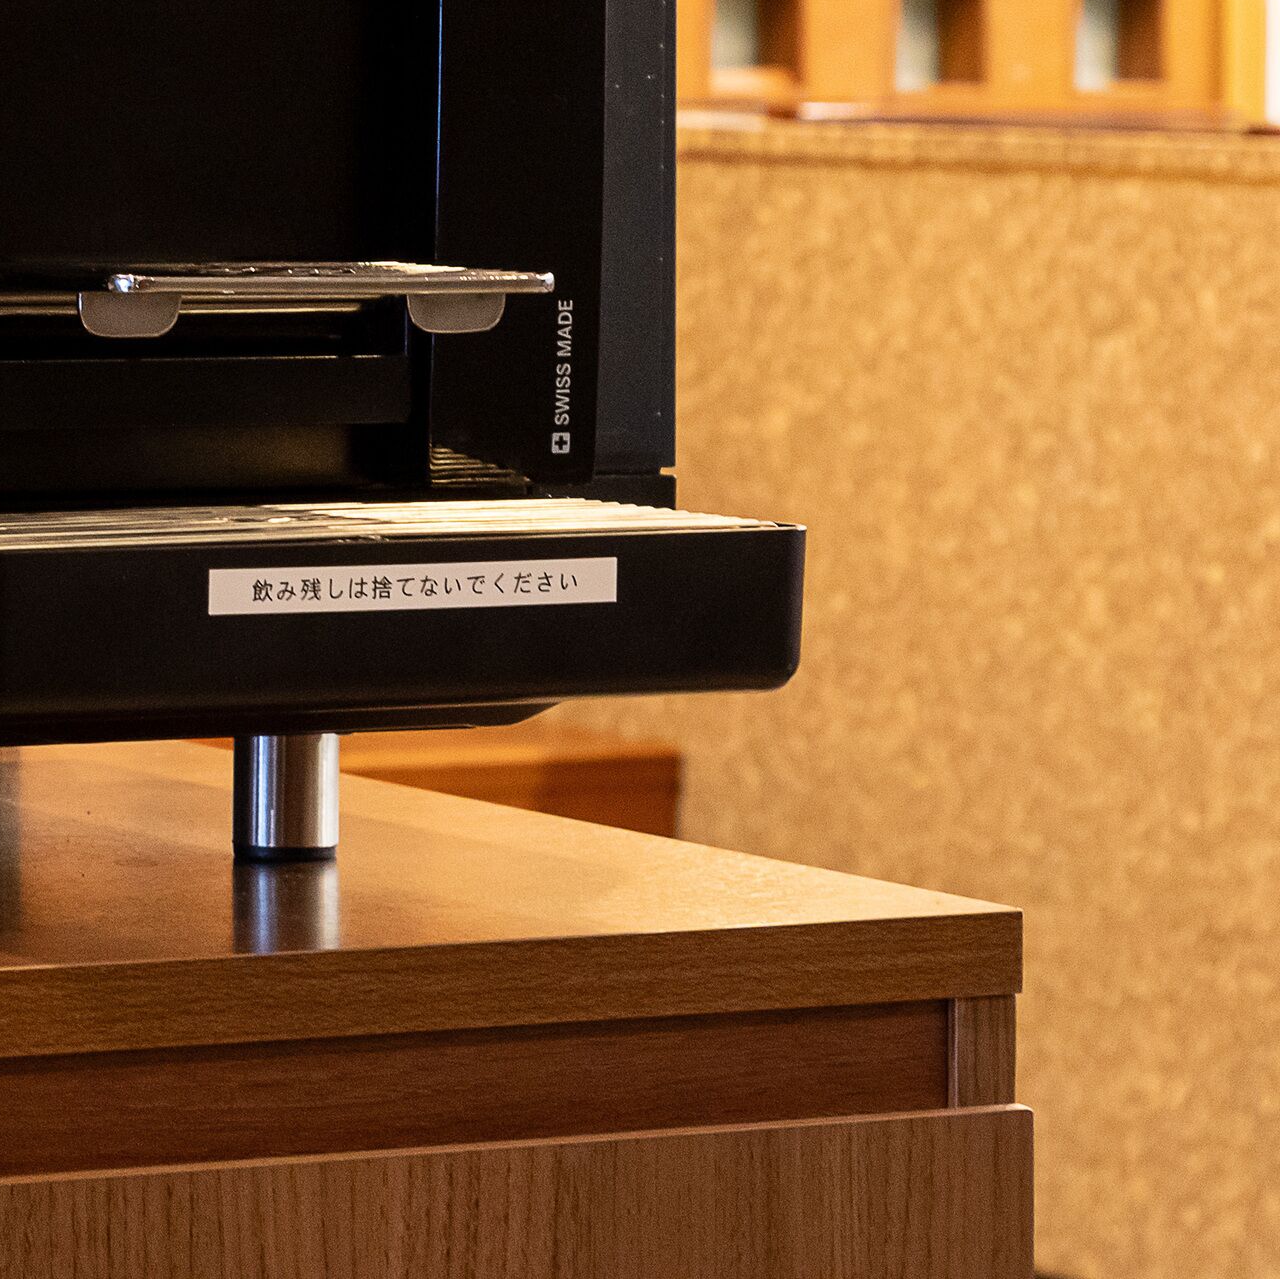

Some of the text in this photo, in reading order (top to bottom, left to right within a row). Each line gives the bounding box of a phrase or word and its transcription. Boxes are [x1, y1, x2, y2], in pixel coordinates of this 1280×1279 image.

[554, 299, 574, 426] SWISS MADE
[252, 572, 578, 602] 飲み残しは捨てないでください
